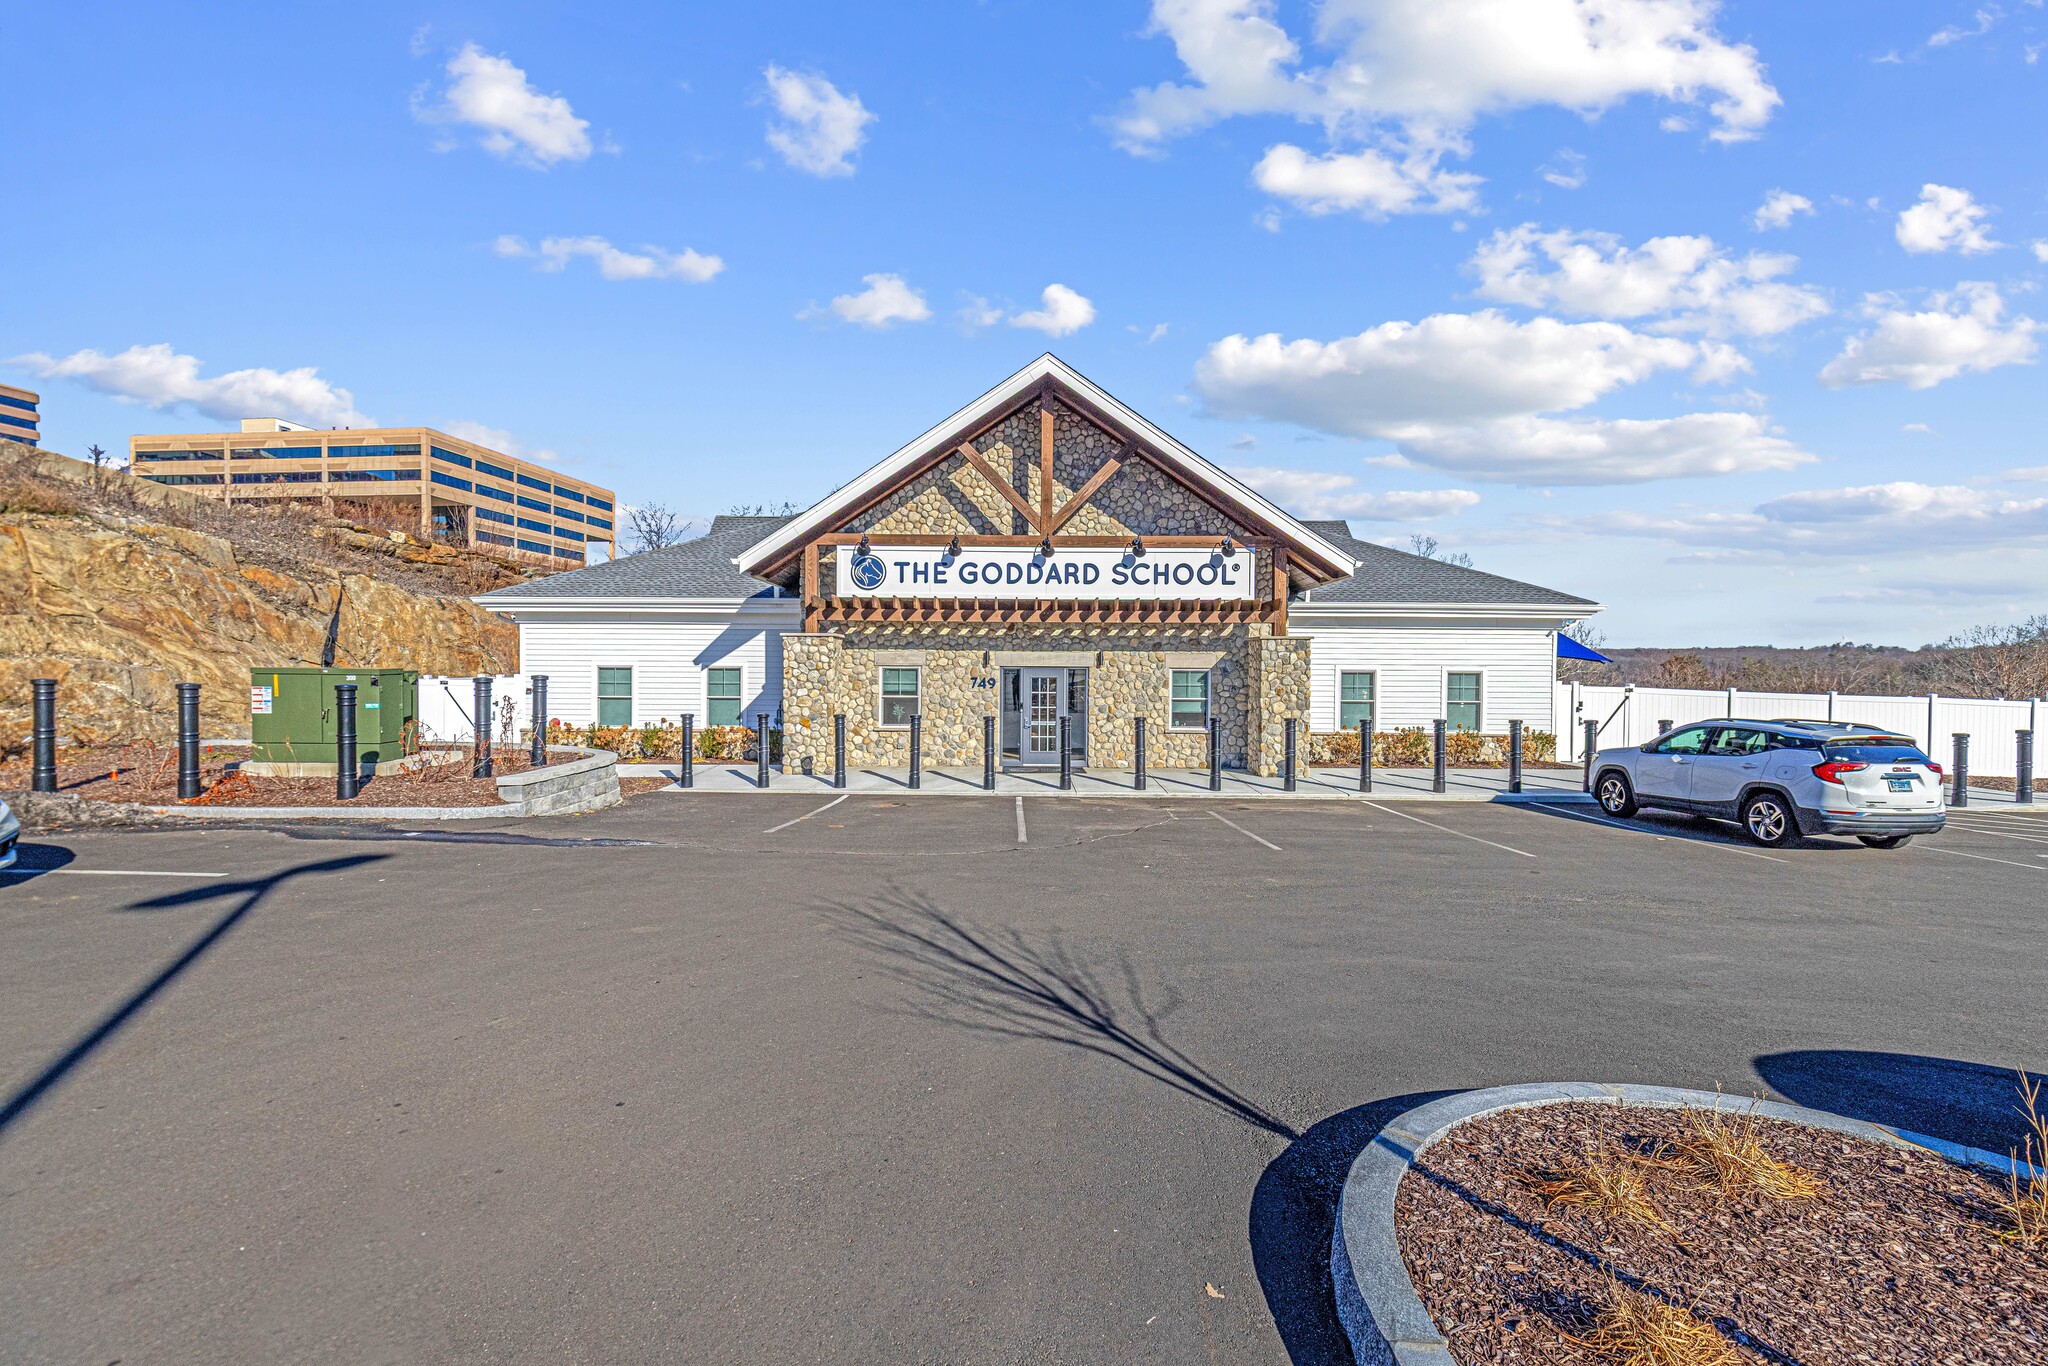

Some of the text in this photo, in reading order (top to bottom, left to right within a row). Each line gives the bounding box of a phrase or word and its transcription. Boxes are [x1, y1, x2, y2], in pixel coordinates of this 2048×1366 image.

[893, 561, 948, 584] THE
[958, 562, 1100, 585] GODDARD
[970, 677, 997, 689] 749
